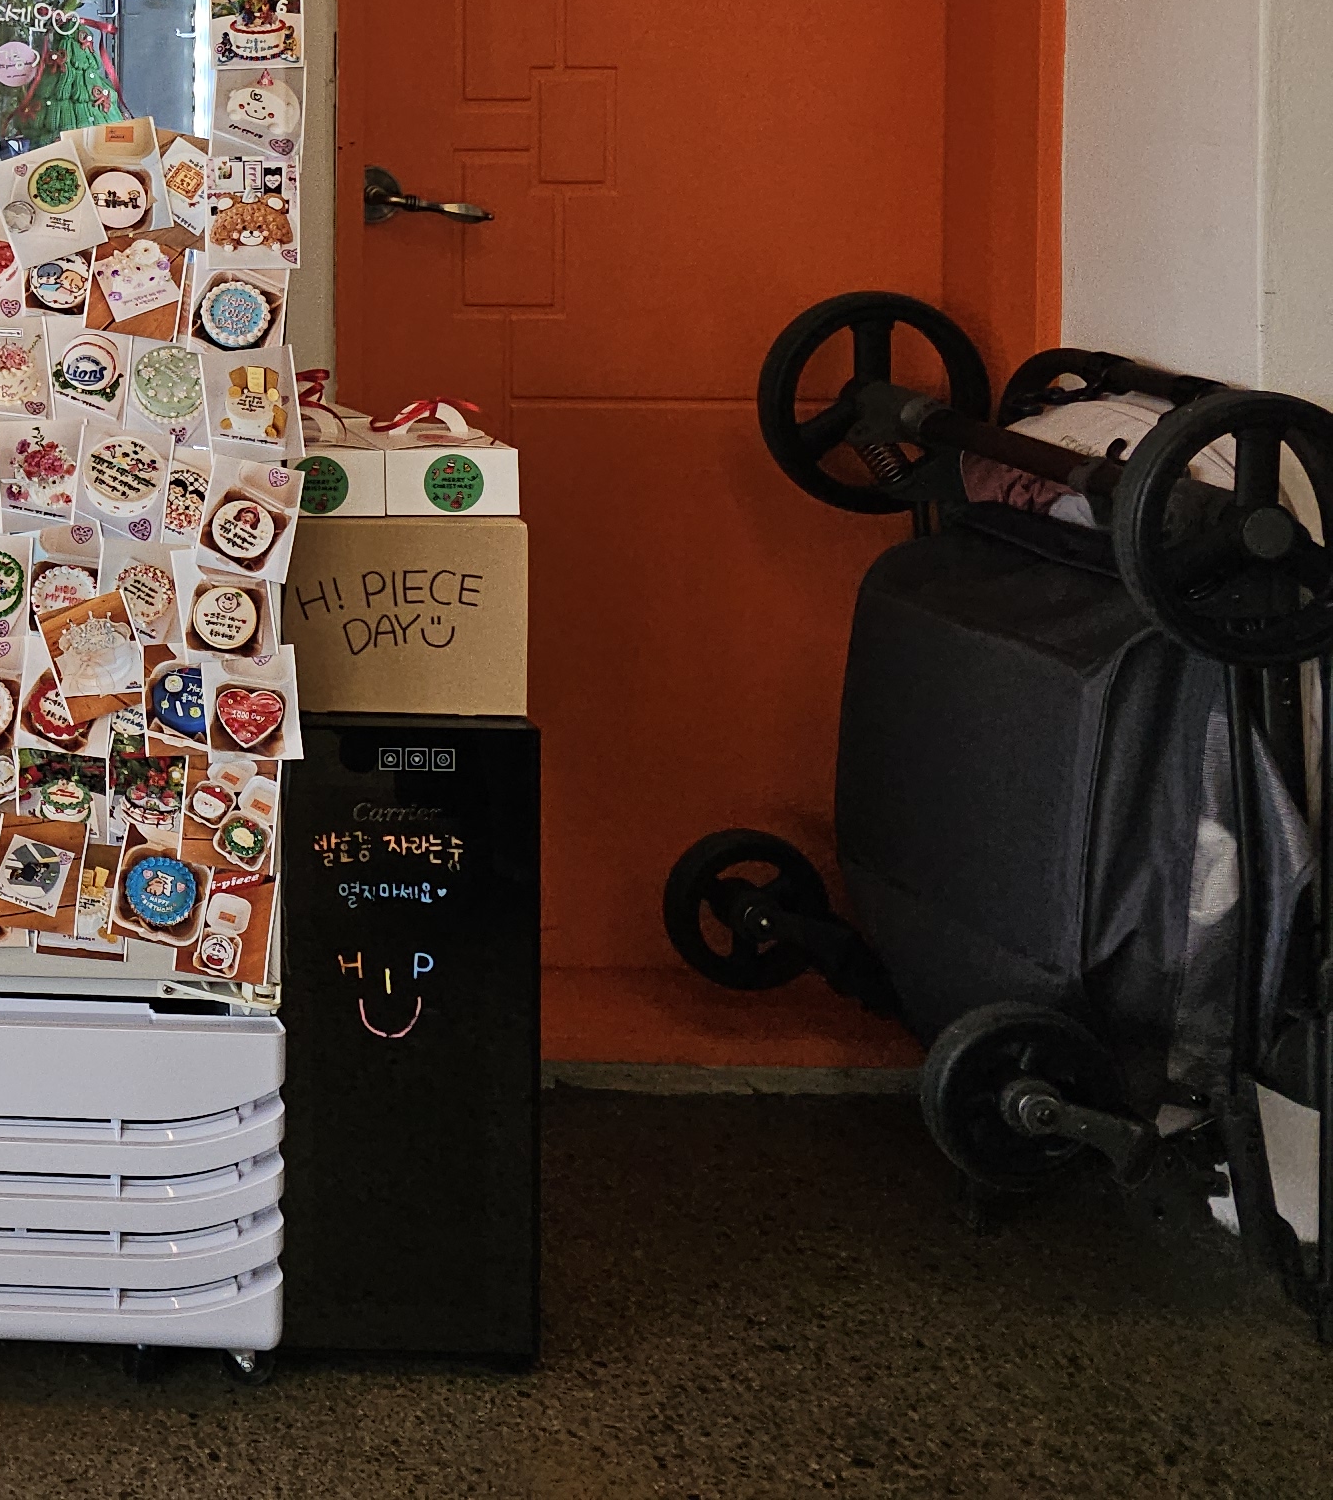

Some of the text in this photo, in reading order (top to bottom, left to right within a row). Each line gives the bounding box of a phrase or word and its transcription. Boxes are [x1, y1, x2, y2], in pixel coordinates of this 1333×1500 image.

[361, 569, 484, 609] PIECE
[342, 612, 422, 656] DAY
[231, 709, 266, 724] 1000 Day
[352, 801, 442, 824] Carrier
[337, 881, 433, 909] 열지마세요
